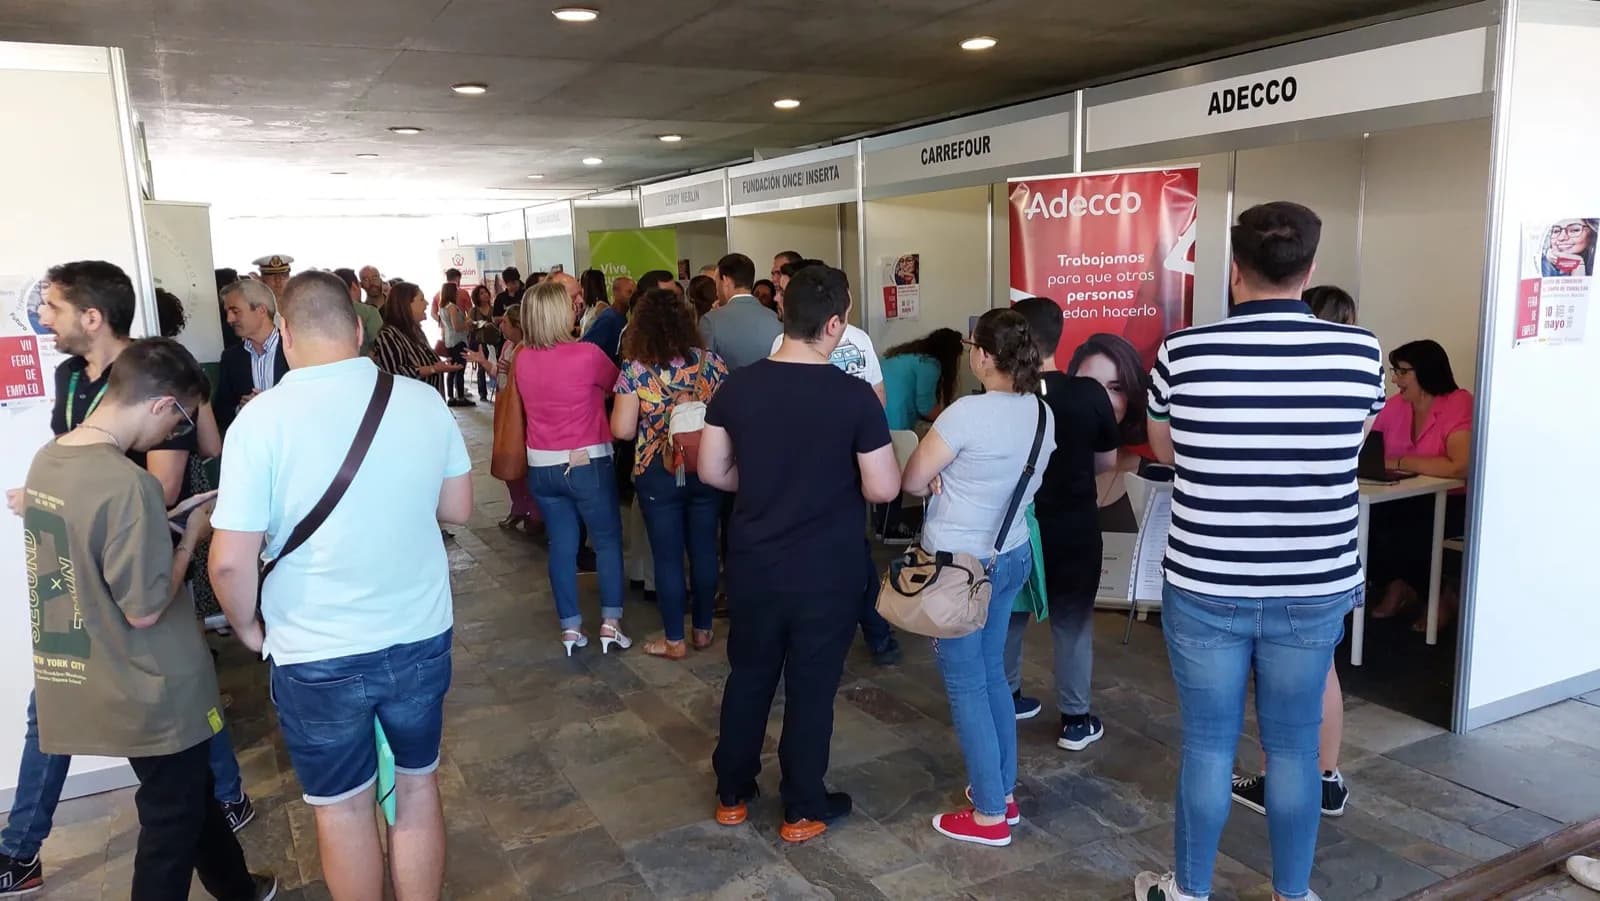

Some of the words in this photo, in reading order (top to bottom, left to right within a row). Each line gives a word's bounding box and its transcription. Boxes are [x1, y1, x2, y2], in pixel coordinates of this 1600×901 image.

[1207, 76, 1298, 116] ADECCO
[920, 135, 991, 166] CARREFOUR
[805, 165, 840, 186] INSERTA
[1025, 189, 1142, 220] Adecco
[1057, 252, 1145, 268] Trabajamos
[1048, 274, 1081, 288] para
[1085, 272, 1112, 287] que
[1116, 270, 1155, 282] otras
[1067, 289, 1134, 304] personas
[1062, 306, 1098, 319] edan
[1102, 303, 1157, 319] hacerlo
[20, 340, 33, 352] VII
[11, 354, 35, 367] FERIA
[25, 368, 37, 380] DE
[5, 382, 39, 398] EMPLEO
[47, 657, 68, 668] YORK
[70, 660, 86, 672] CITY
